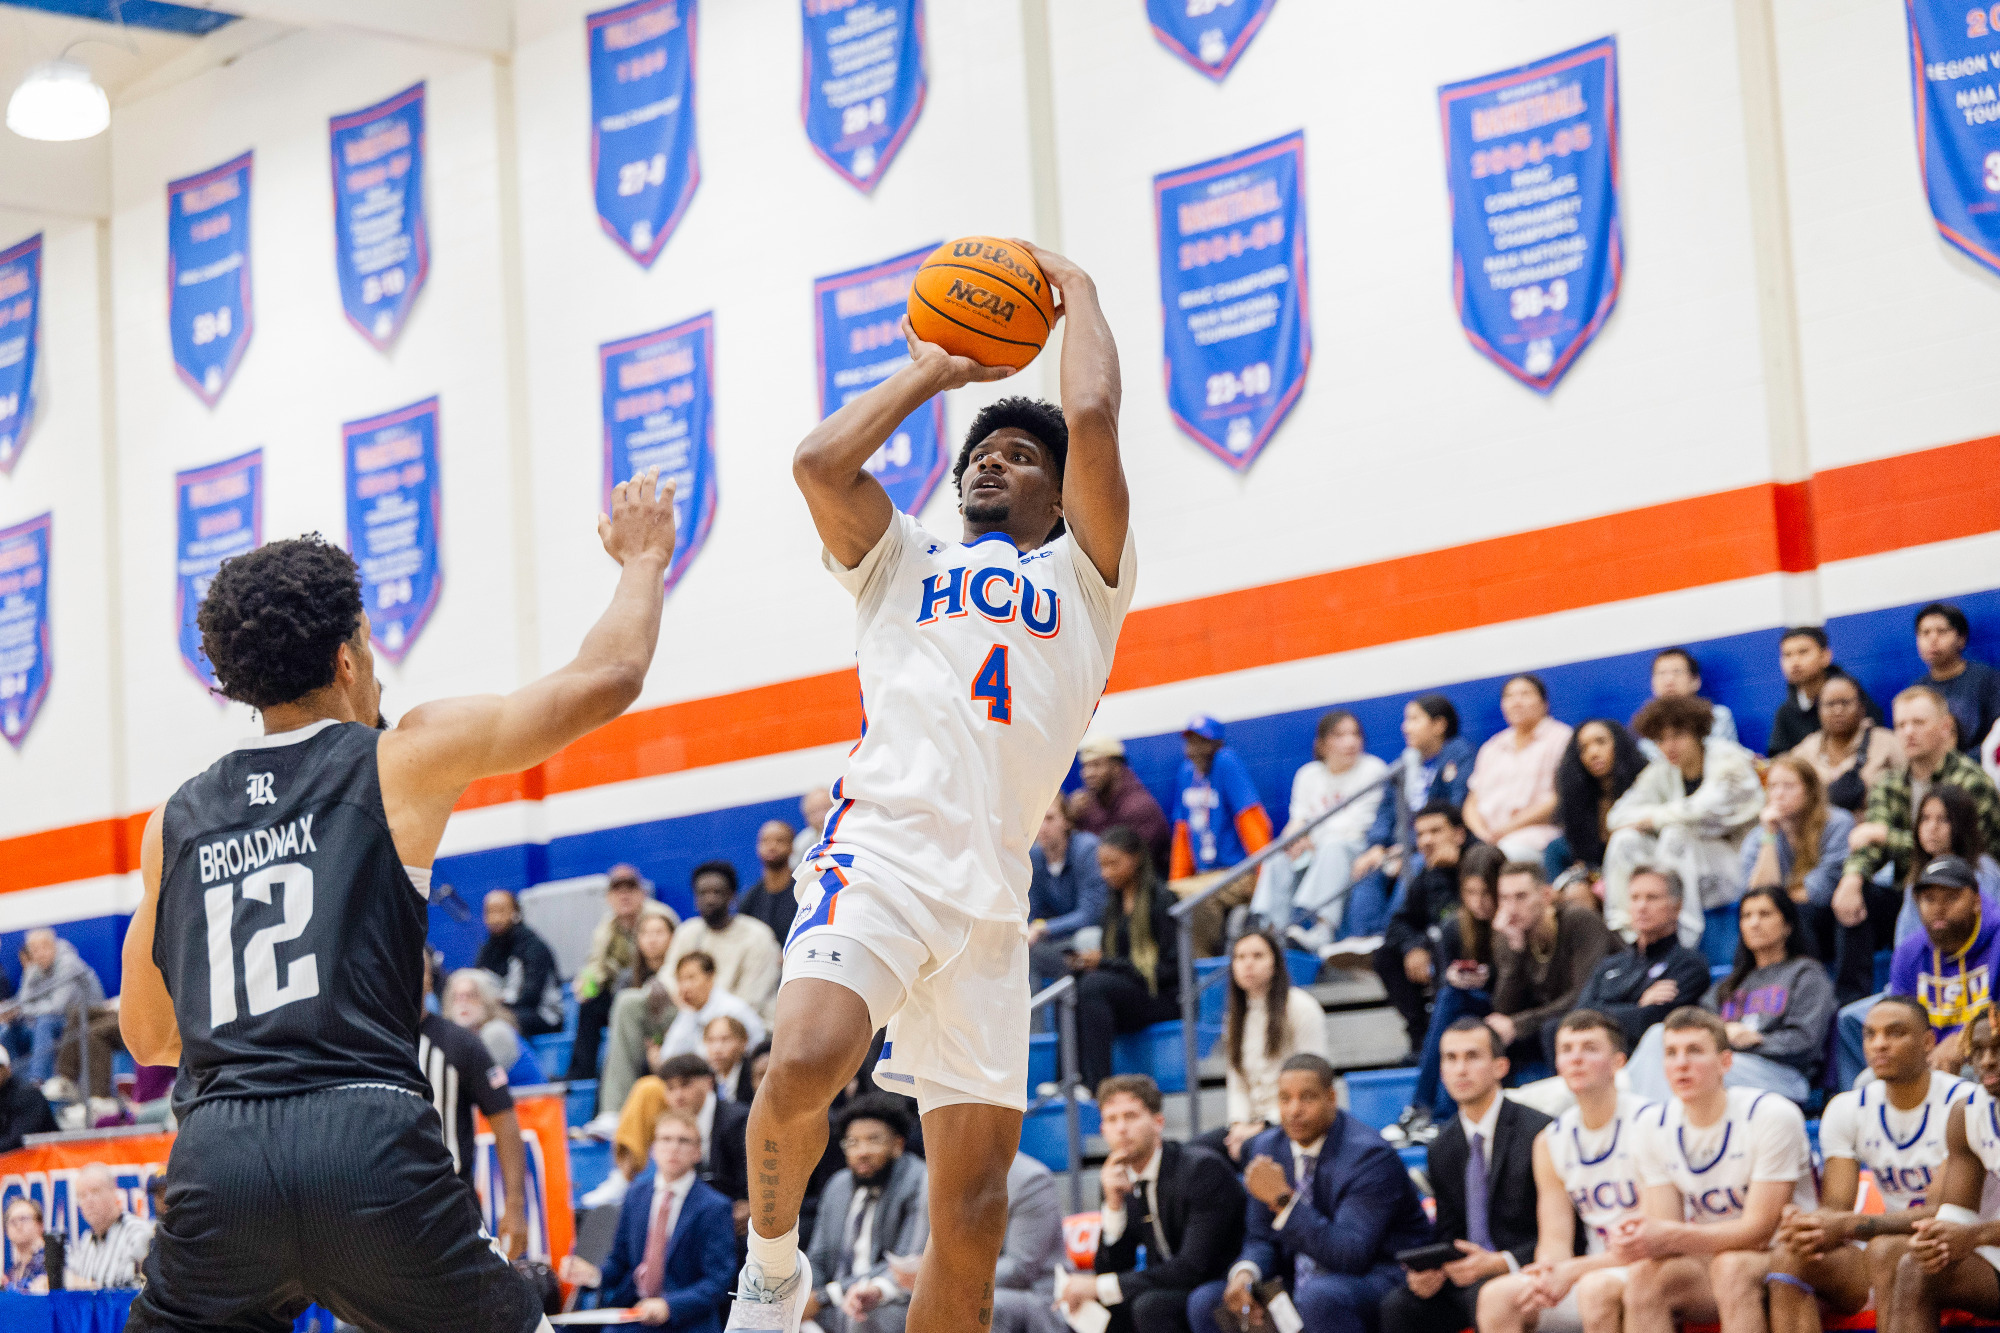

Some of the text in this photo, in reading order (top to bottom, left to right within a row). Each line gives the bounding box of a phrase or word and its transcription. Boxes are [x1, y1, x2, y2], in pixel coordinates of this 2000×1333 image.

[946, 278, 1015, 322] NCAA
[952, 242, 1042, 296] Wilson
[916, 566, 1061, 640] HCU
[971, 643, 1012, 726] 4
[246, 771, 278, 807] R
[199, 813, 317, 883] BROADNAX
[204, 862, 320, 1029] 12
[1569, 1179, 1640, 1219] HCU
